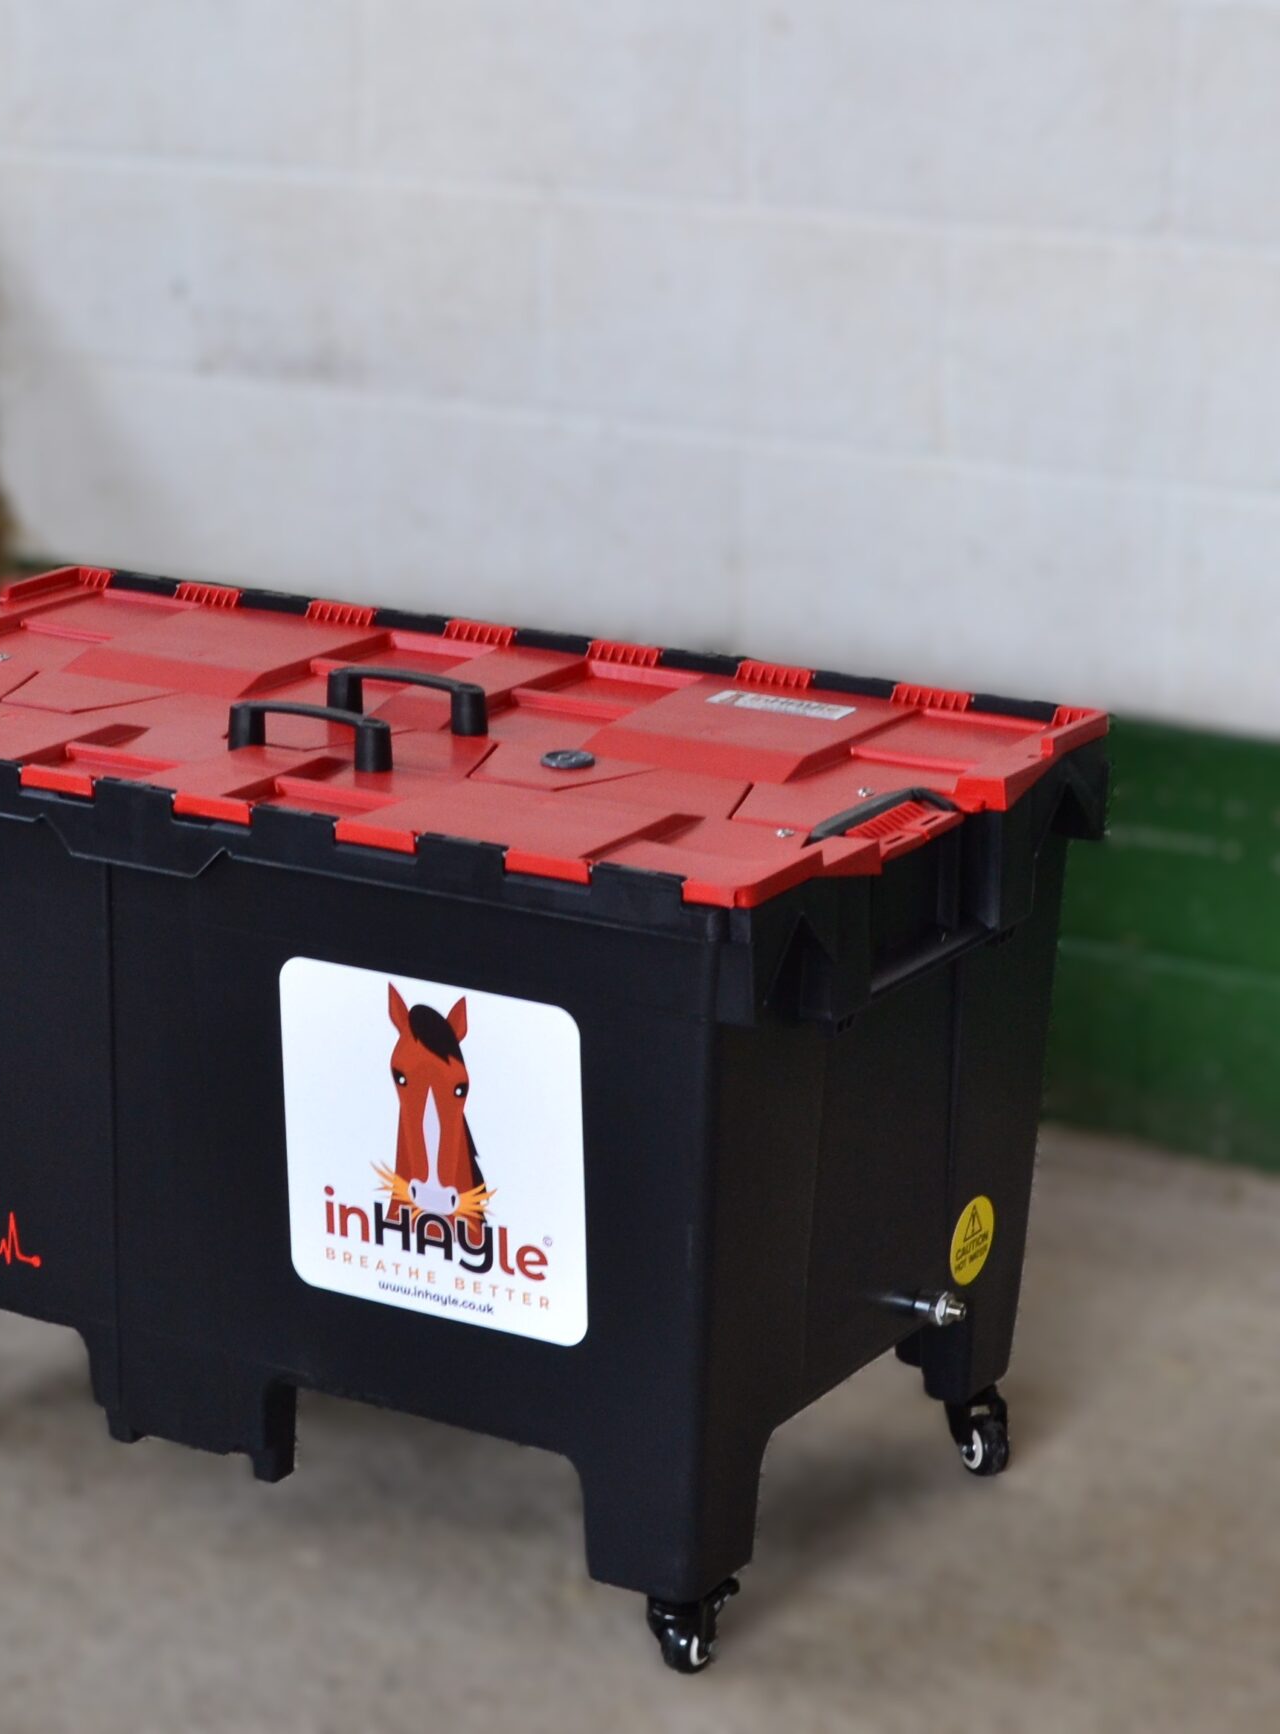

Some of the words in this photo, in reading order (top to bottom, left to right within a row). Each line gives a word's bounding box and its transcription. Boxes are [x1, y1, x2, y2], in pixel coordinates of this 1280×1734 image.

[956, 1231, 989, 1261] CAUTION
[325, 1248, 436, 1284] BREATHE
[454, 1277, 551, 1310] BETTER
[378, 1280, 494, 1315] www.inhayle.co.uk
